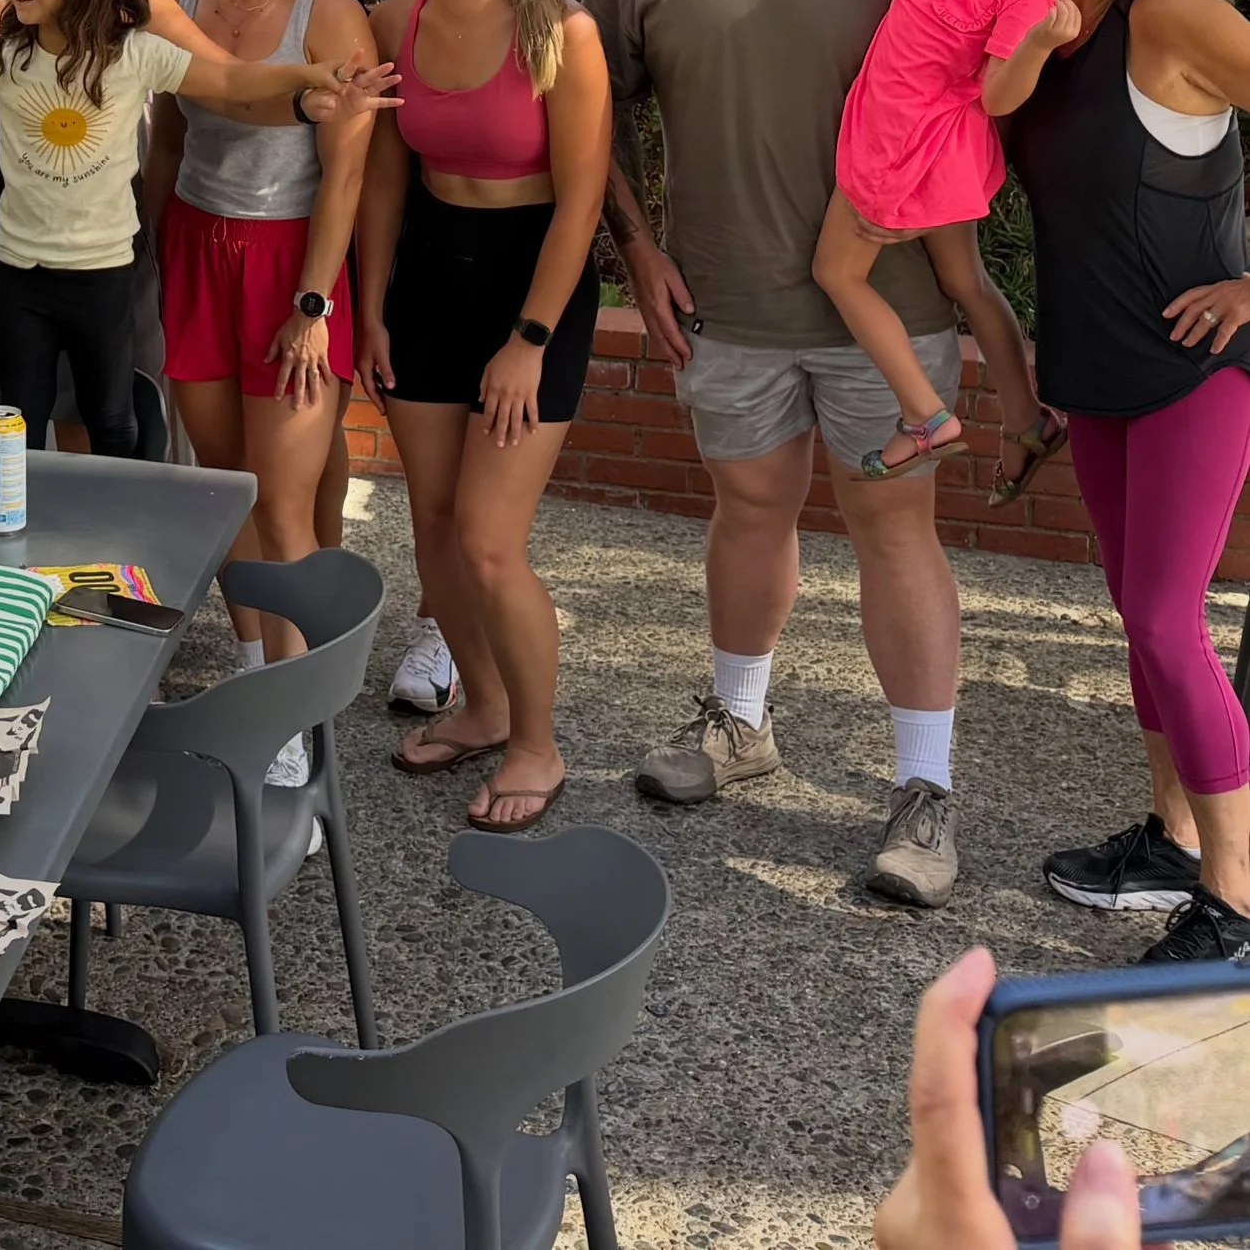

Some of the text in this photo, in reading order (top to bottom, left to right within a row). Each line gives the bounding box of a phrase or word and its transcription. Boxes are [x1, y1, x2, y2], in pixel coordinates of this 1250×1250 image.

[18, 152, 111, 188] you are my sunshine
